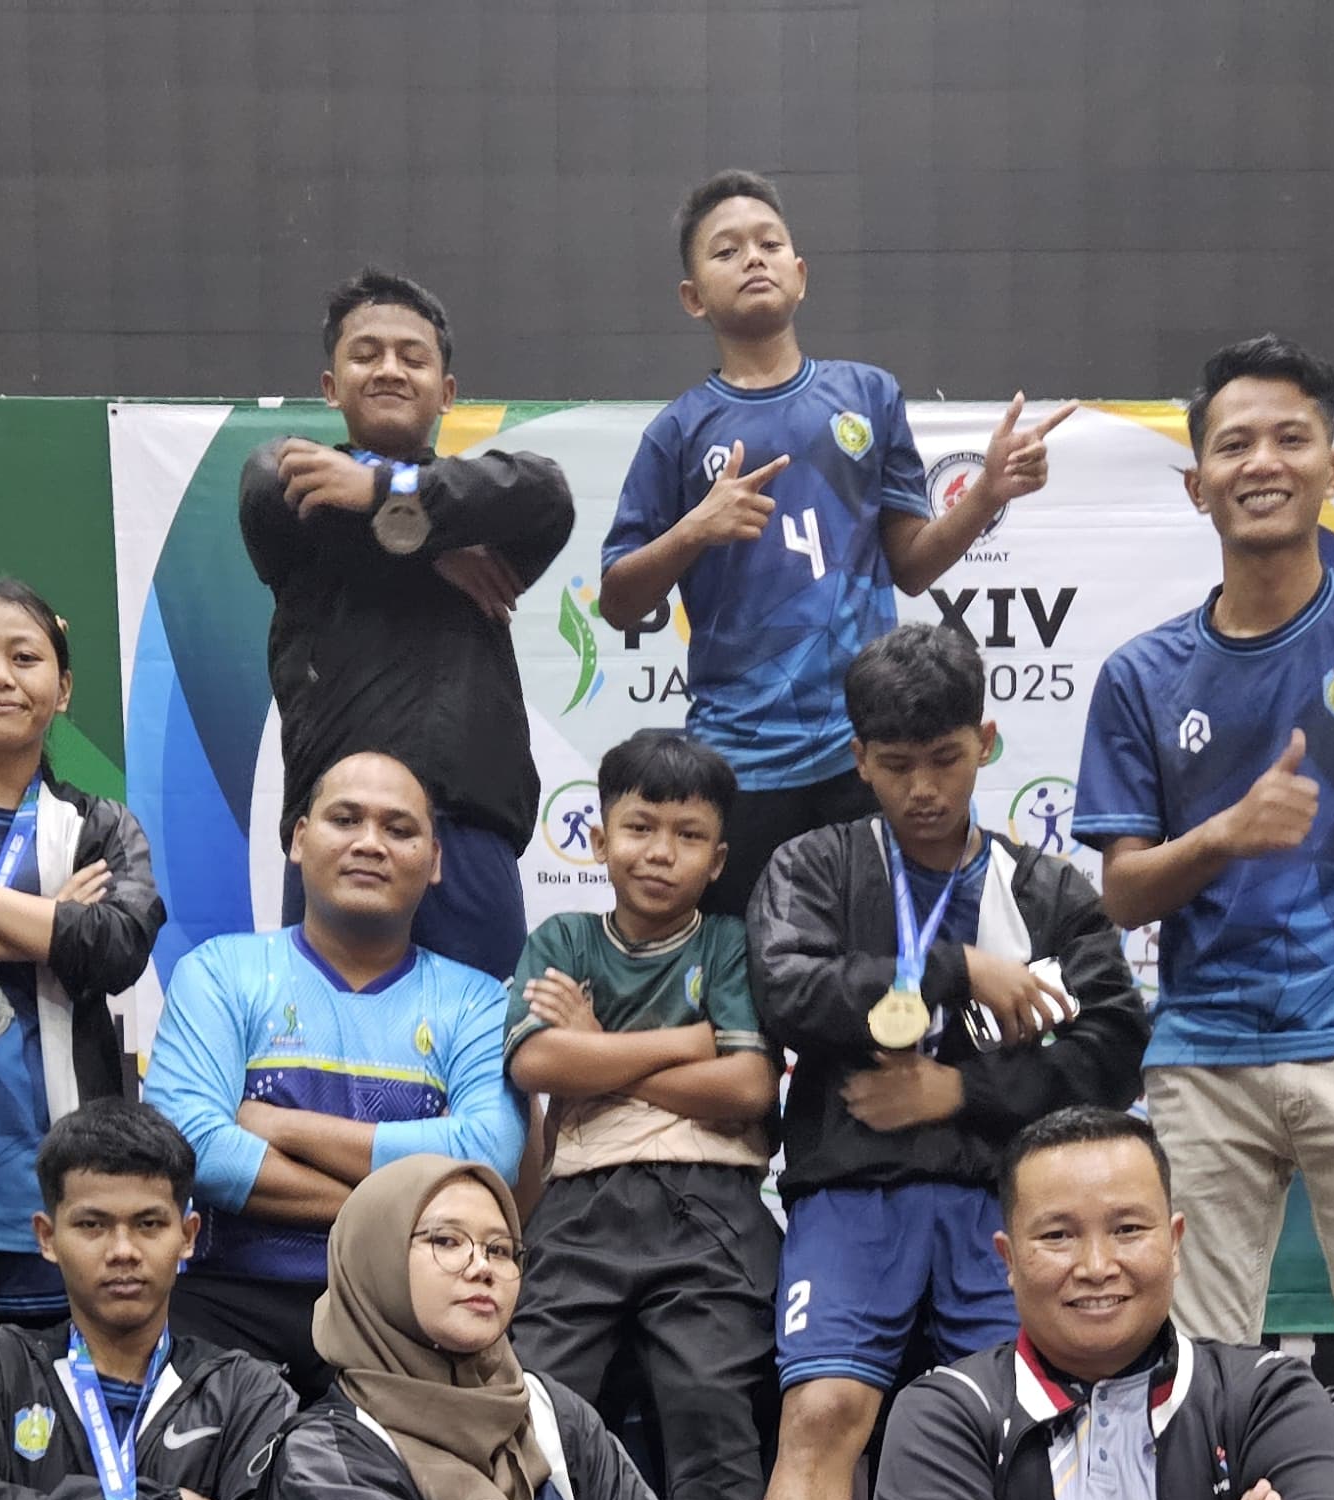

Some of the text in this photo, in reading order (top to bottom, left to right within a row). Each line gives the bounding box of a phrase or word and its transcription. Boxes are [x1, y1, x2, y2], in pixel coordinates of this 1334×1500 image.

[781, 507, 826, 580] 4
[927, 587, 1078, 649] XIV
[628, 663, 1075, 703] JA 025
[537, 871, 609, 884] Bola Bas
[784, 1279, 811, 1337] 2
